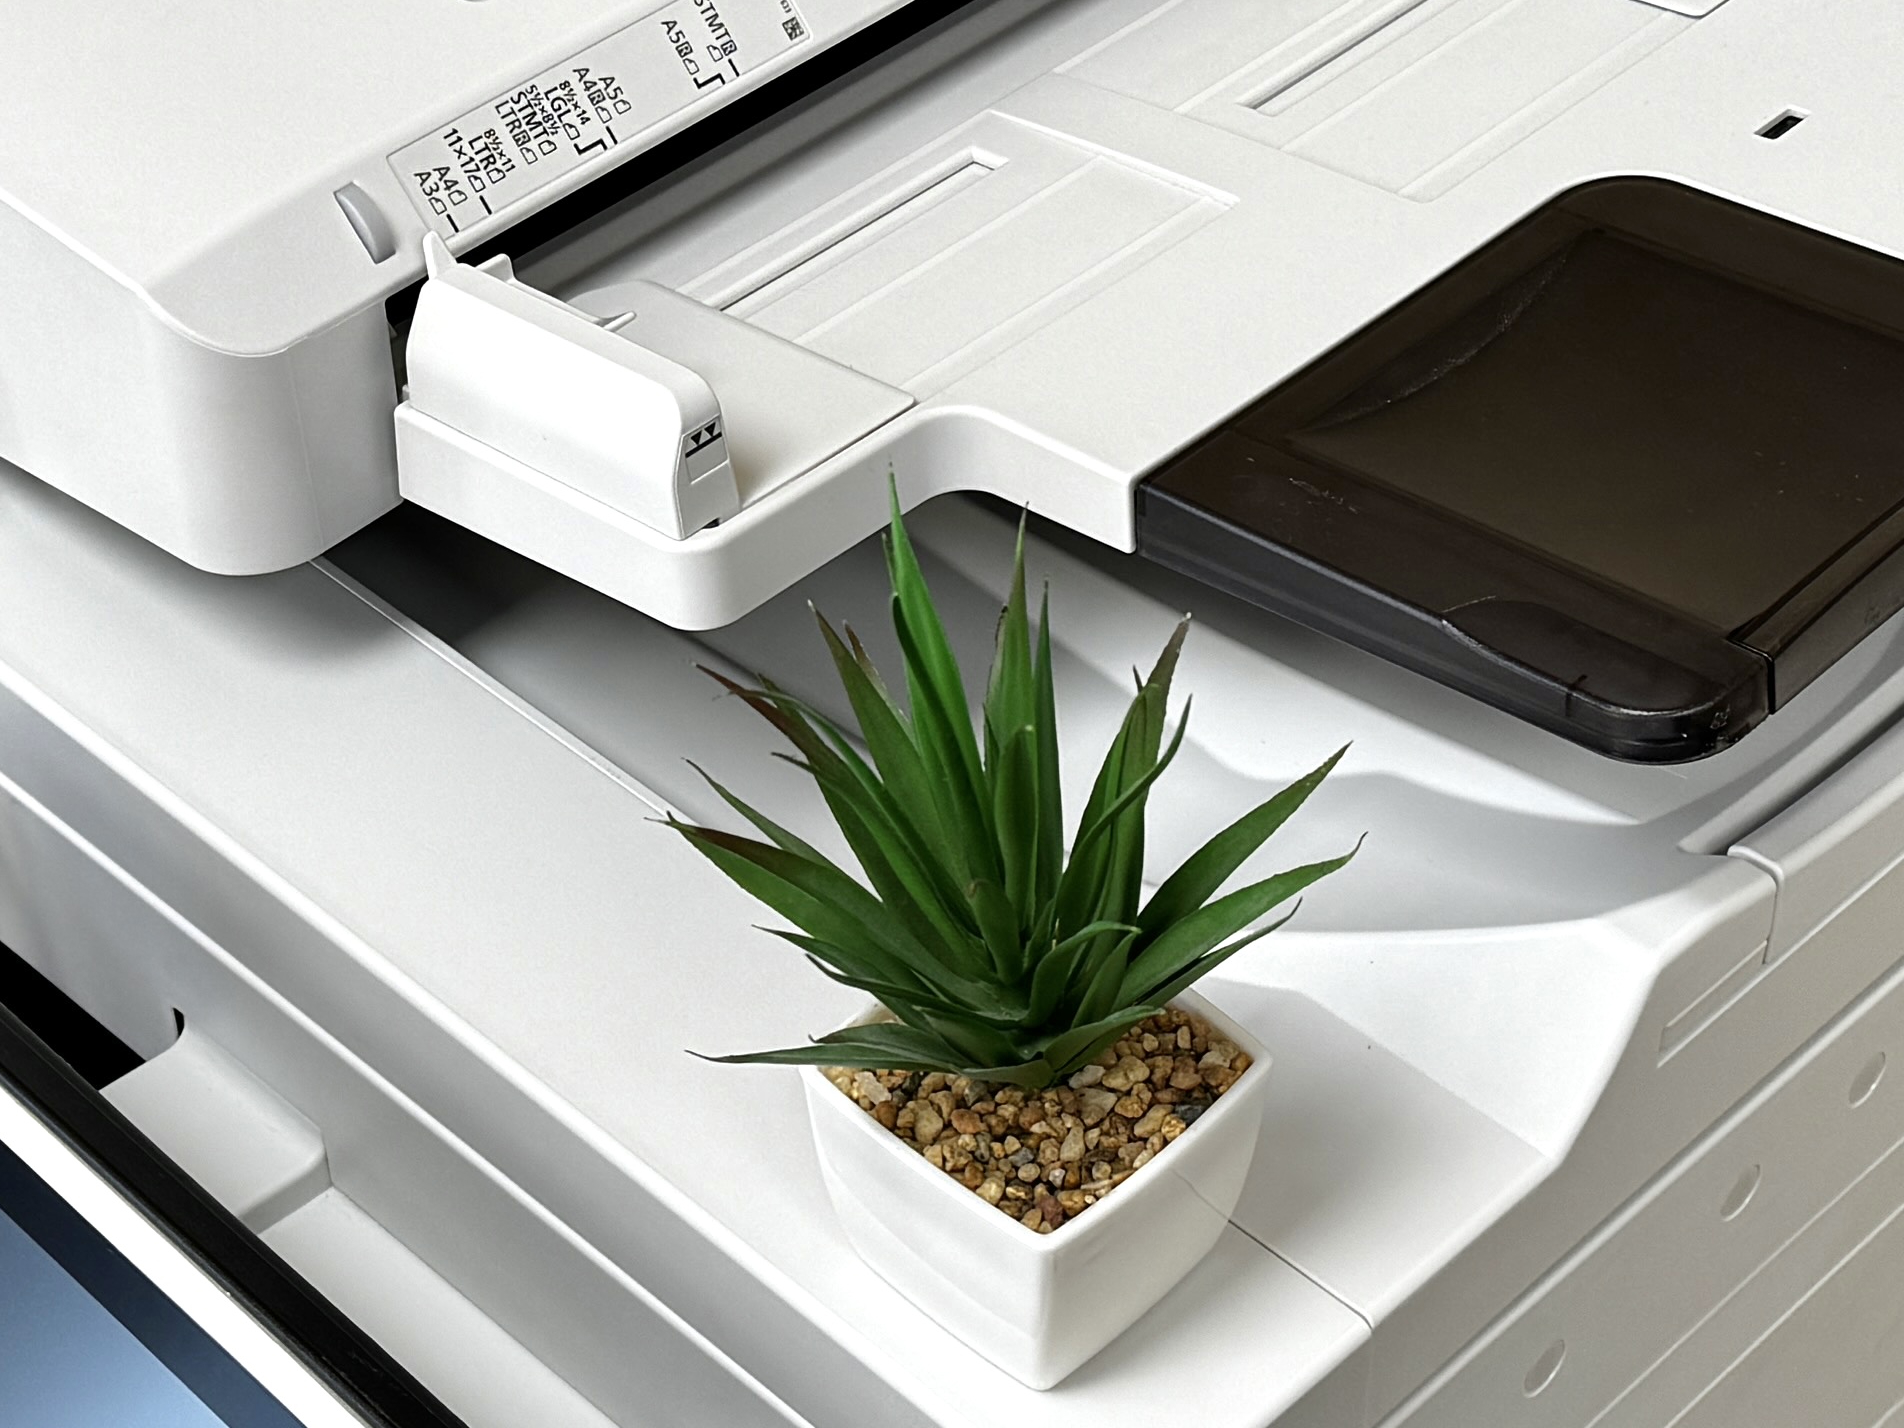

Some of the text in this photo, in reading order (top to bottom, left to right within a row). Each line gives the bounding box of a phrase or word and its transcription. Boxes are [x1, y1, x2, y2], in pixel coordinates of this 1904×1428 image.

[598, 76, 624, 100] A5
[510, 91, 549, 139] STMT
[544, 86, 571, 123] LGL
[468, 135, 497, 170] LTR
[413, 171, 440, 197] A3
[432, 166, 459, 191] A4
